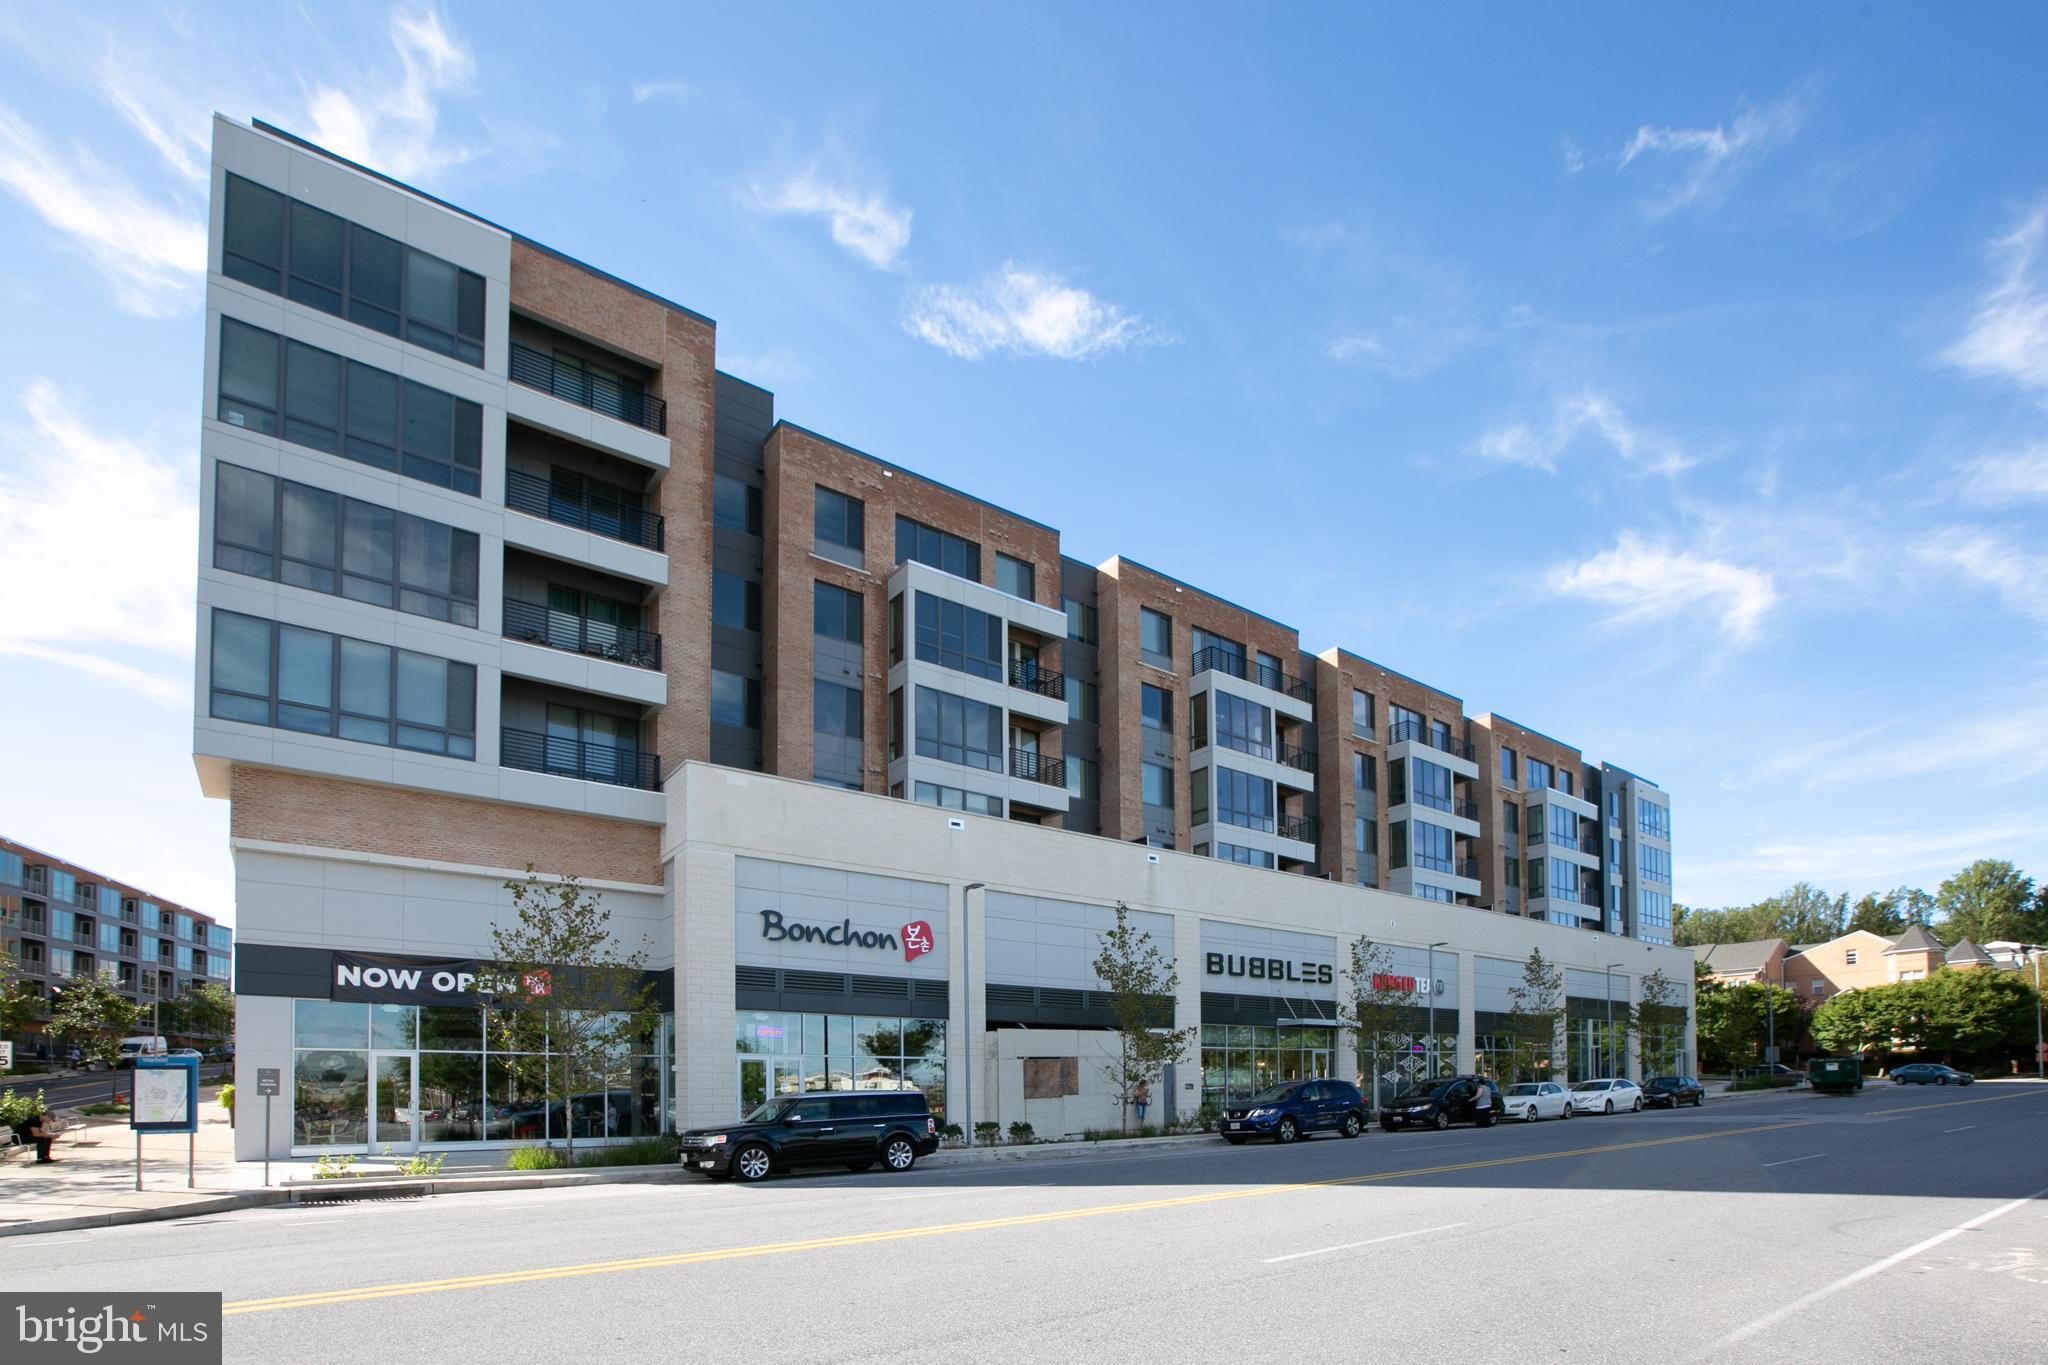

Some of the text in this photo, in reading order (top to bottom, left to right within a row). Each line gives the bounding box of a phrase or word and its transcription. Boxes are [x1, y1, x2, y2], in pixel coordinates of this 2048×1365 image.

[760, 909, 898, 951] Bonchon
[905, 924, 930, 953] 본촌
[336, 964, 422, 991] NOW
[1206, 951, 1333, 984] BUBBLES
